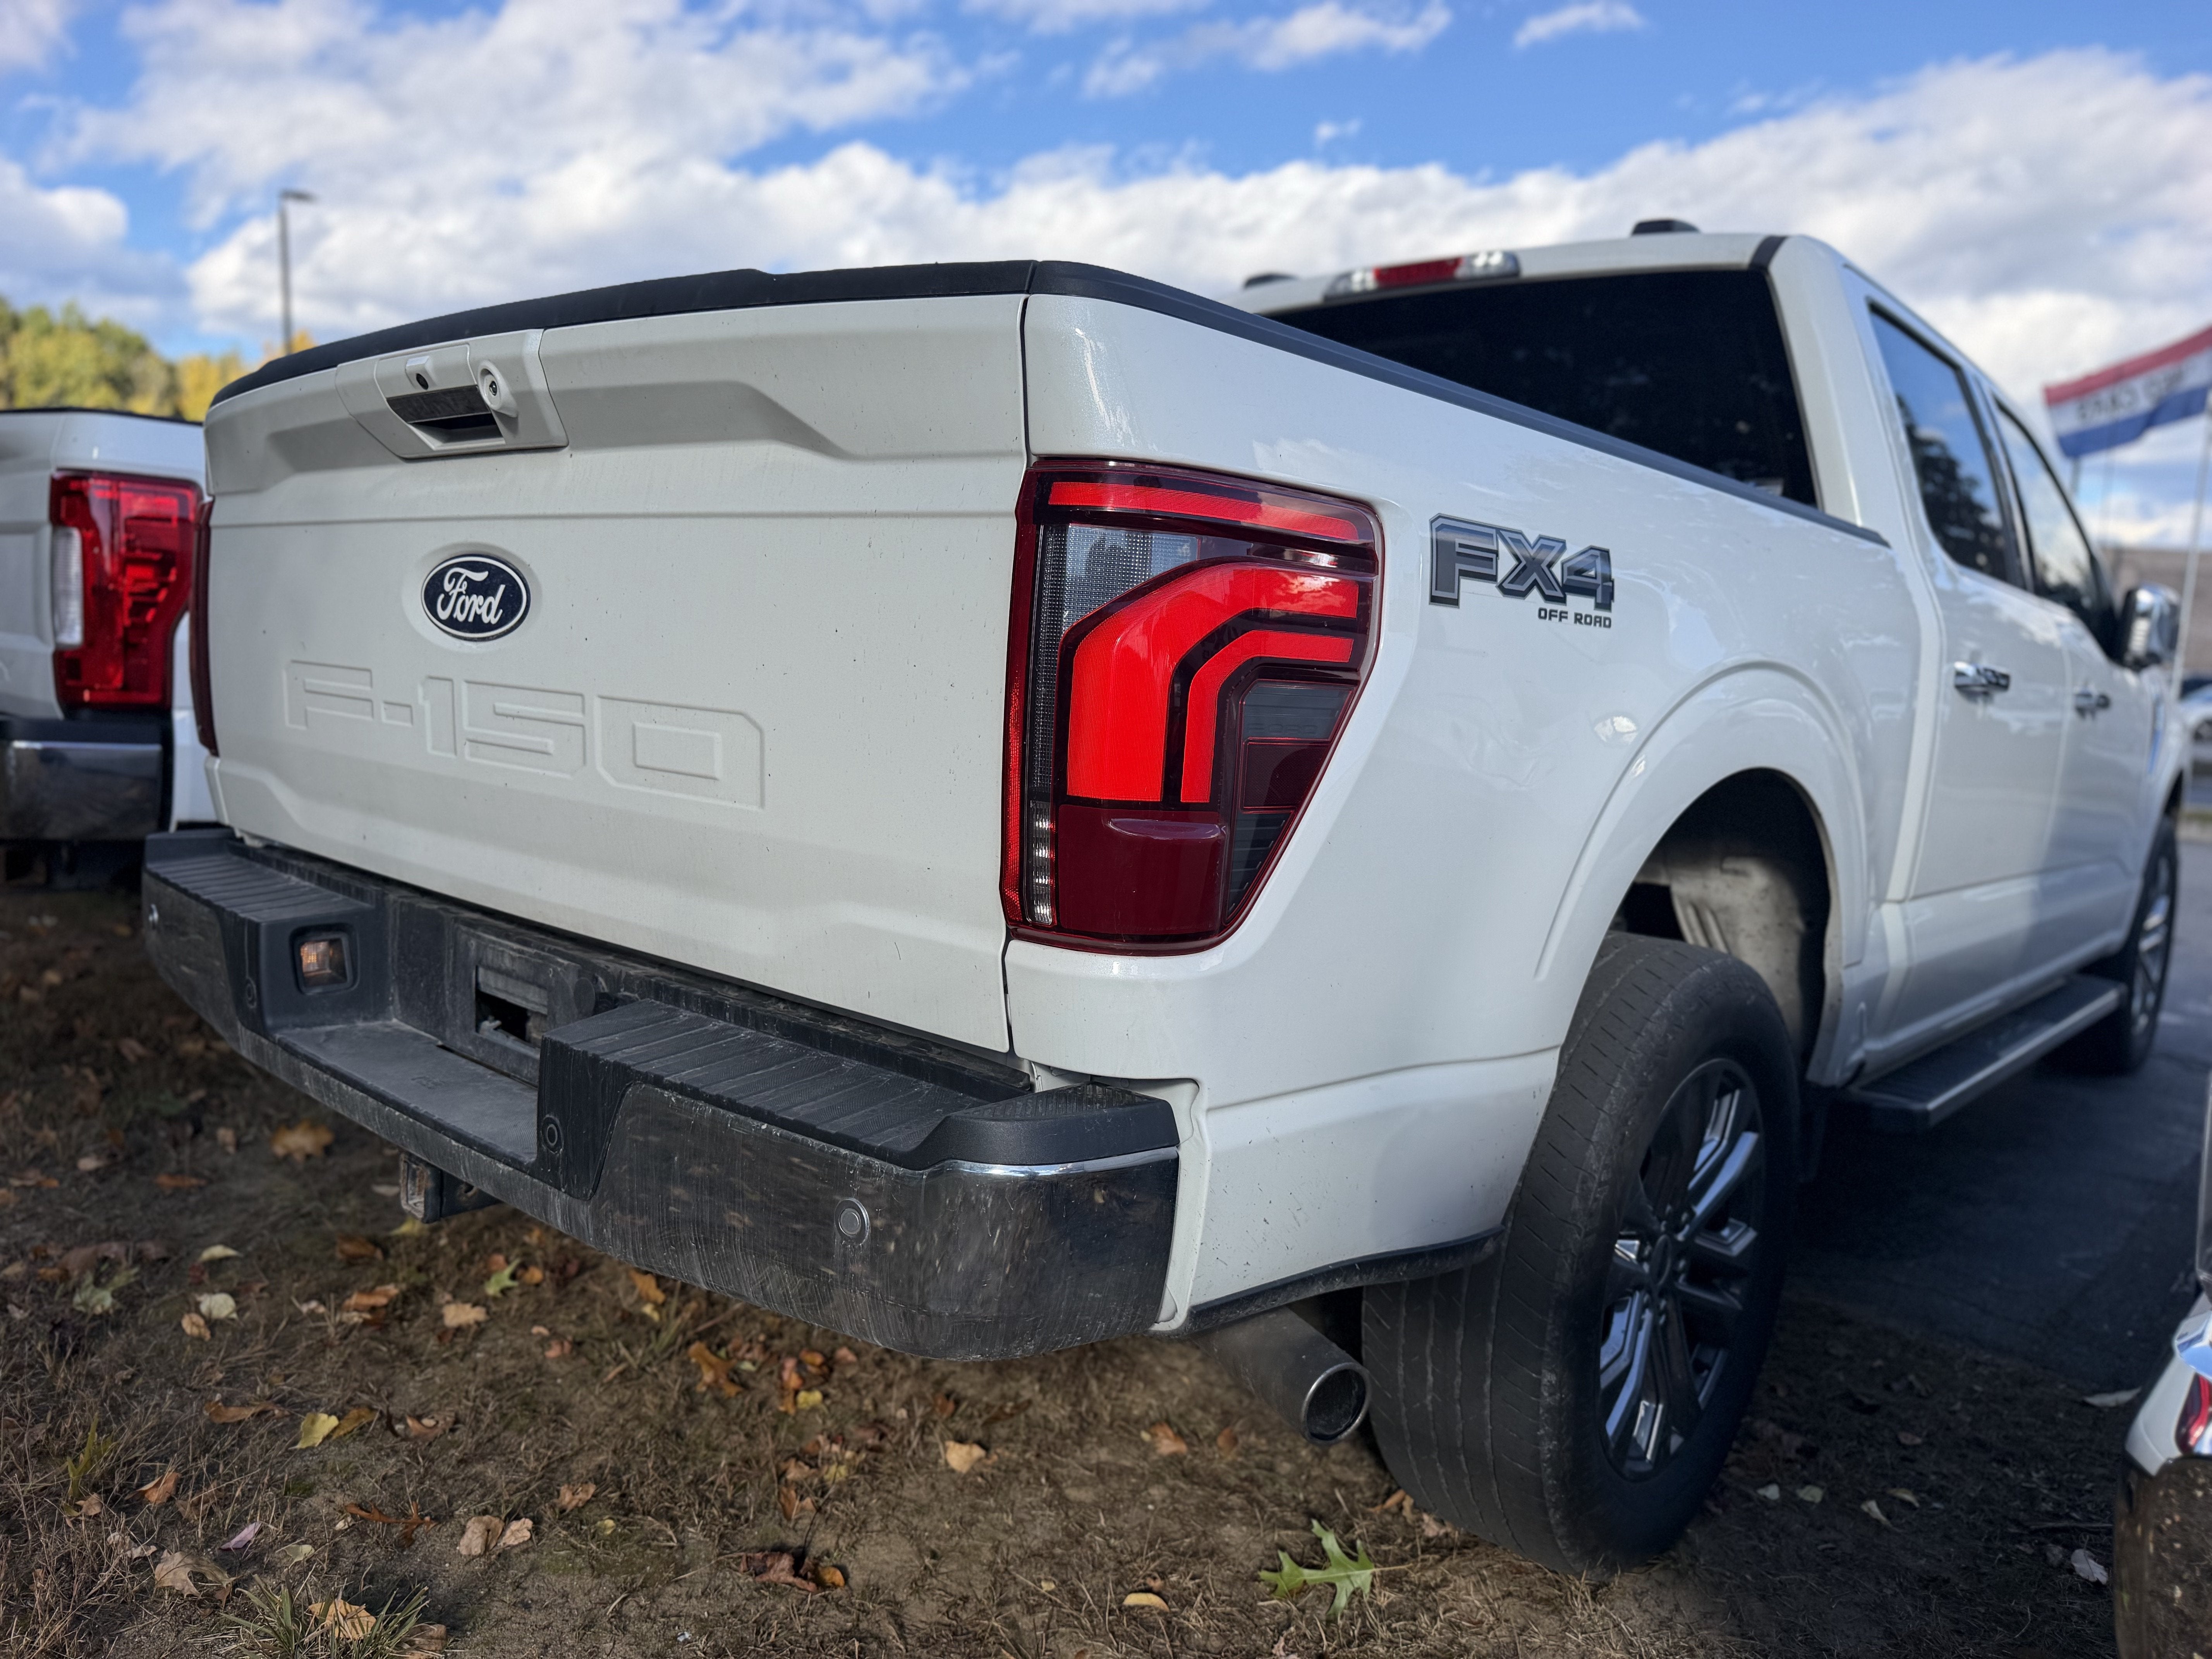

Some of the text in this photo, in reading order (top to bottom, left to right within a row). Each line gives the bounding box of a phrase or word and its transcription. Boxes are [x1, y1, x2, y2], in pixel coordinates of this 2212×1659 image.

[437, 567, 505, 624] Ford
[1429, 513, 1614, 613] FX4
[1538, 607, 1611, 629] OFF ROAD
[285, 660, 765, 811] F-150
